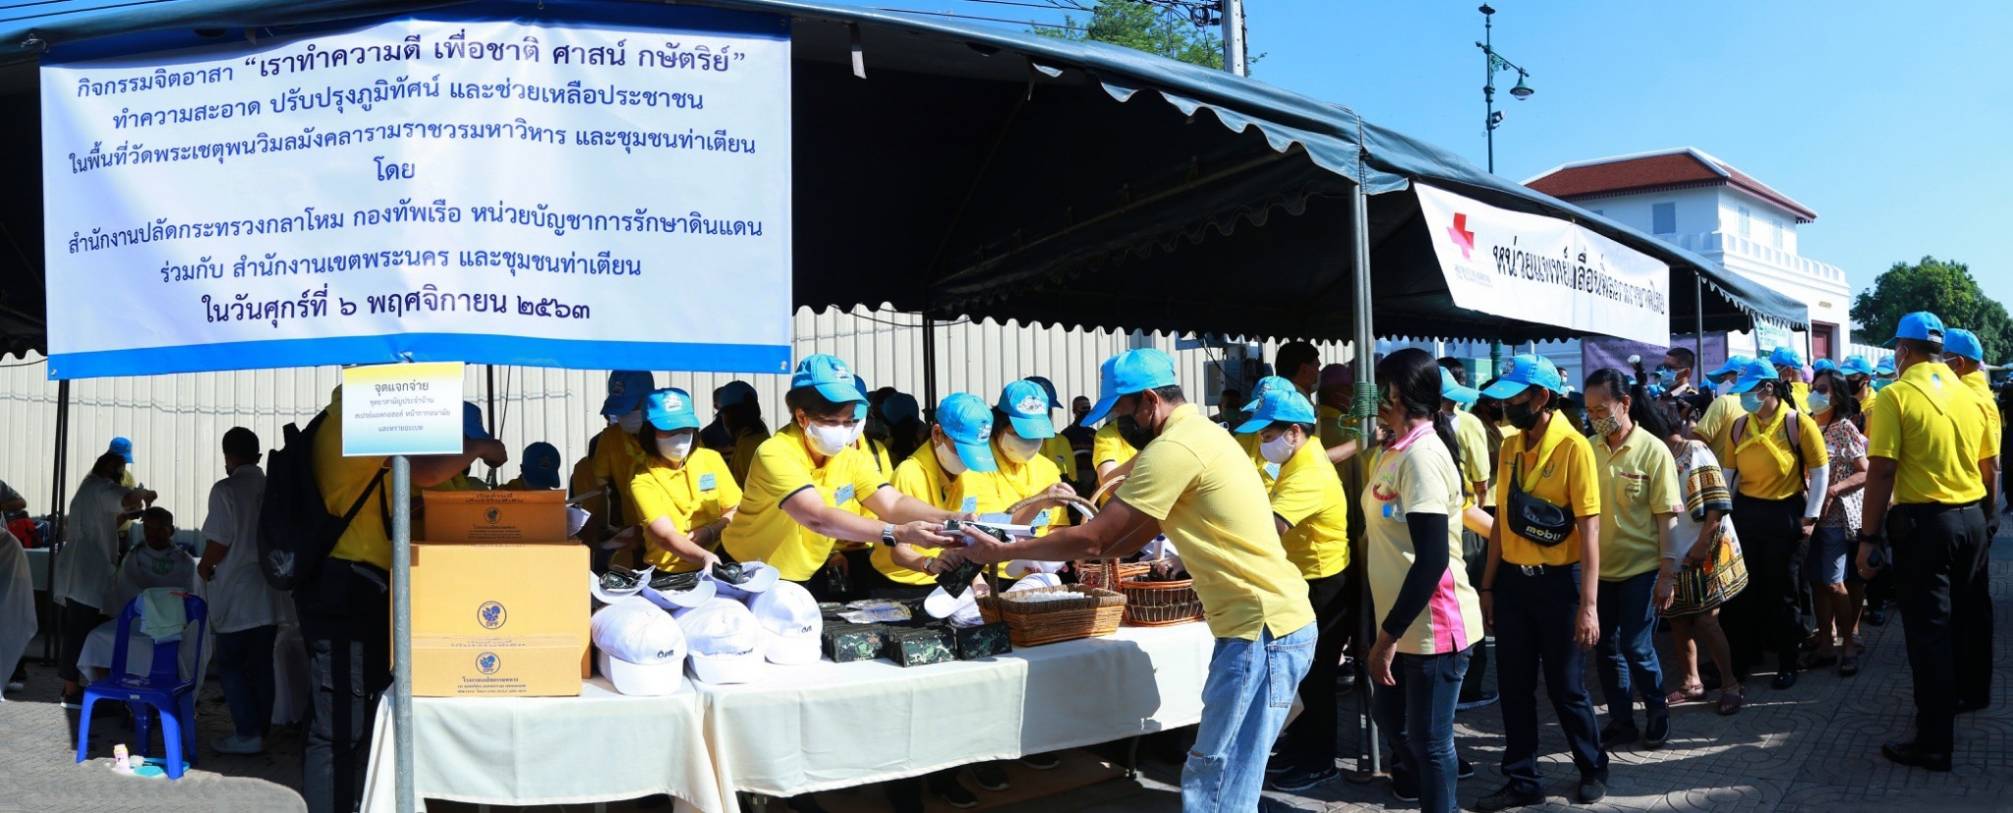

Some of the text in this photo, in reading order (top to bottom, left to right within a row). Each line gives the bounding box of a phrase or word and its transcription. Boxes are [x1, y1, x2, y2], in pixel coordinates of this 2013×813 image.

[77, 65, 233, 97] กิจกรรมจิตอาสา
[434, 28, 540, 62] เพื่อชาติ
[552, 38, 626, 66] ศาสน์
[113, 74, 704, 130] ทำความสะอาด ปรับปรุงภูมิทัศน์ และช่วยเหลือประชาชน
[69, 117, 755, 174] ในพื้นที่วัดพระเชตุพนวิมลมังคลารามราชวรมหาวิหาร และชุมชนท่าเตียน
[373, 156, 416, 182] โดย
[68, 198, 763, 254] สำนักงานปลัดกระทรวงกลาโหม กองทัพเรือ หน่วยบัญชาการรักษาดินแดน
[160, 249, 641, 283] ร่วมกับ สำนักงานเขตพระนคร และชุมชนท่าเตียน
[202, 283, 590, 328] ในวันศุกร์ที่ ๖ พฤศจิกายน ๒๕๖๓
[375, 379, 430, 397] จุดแจกจ่าย
